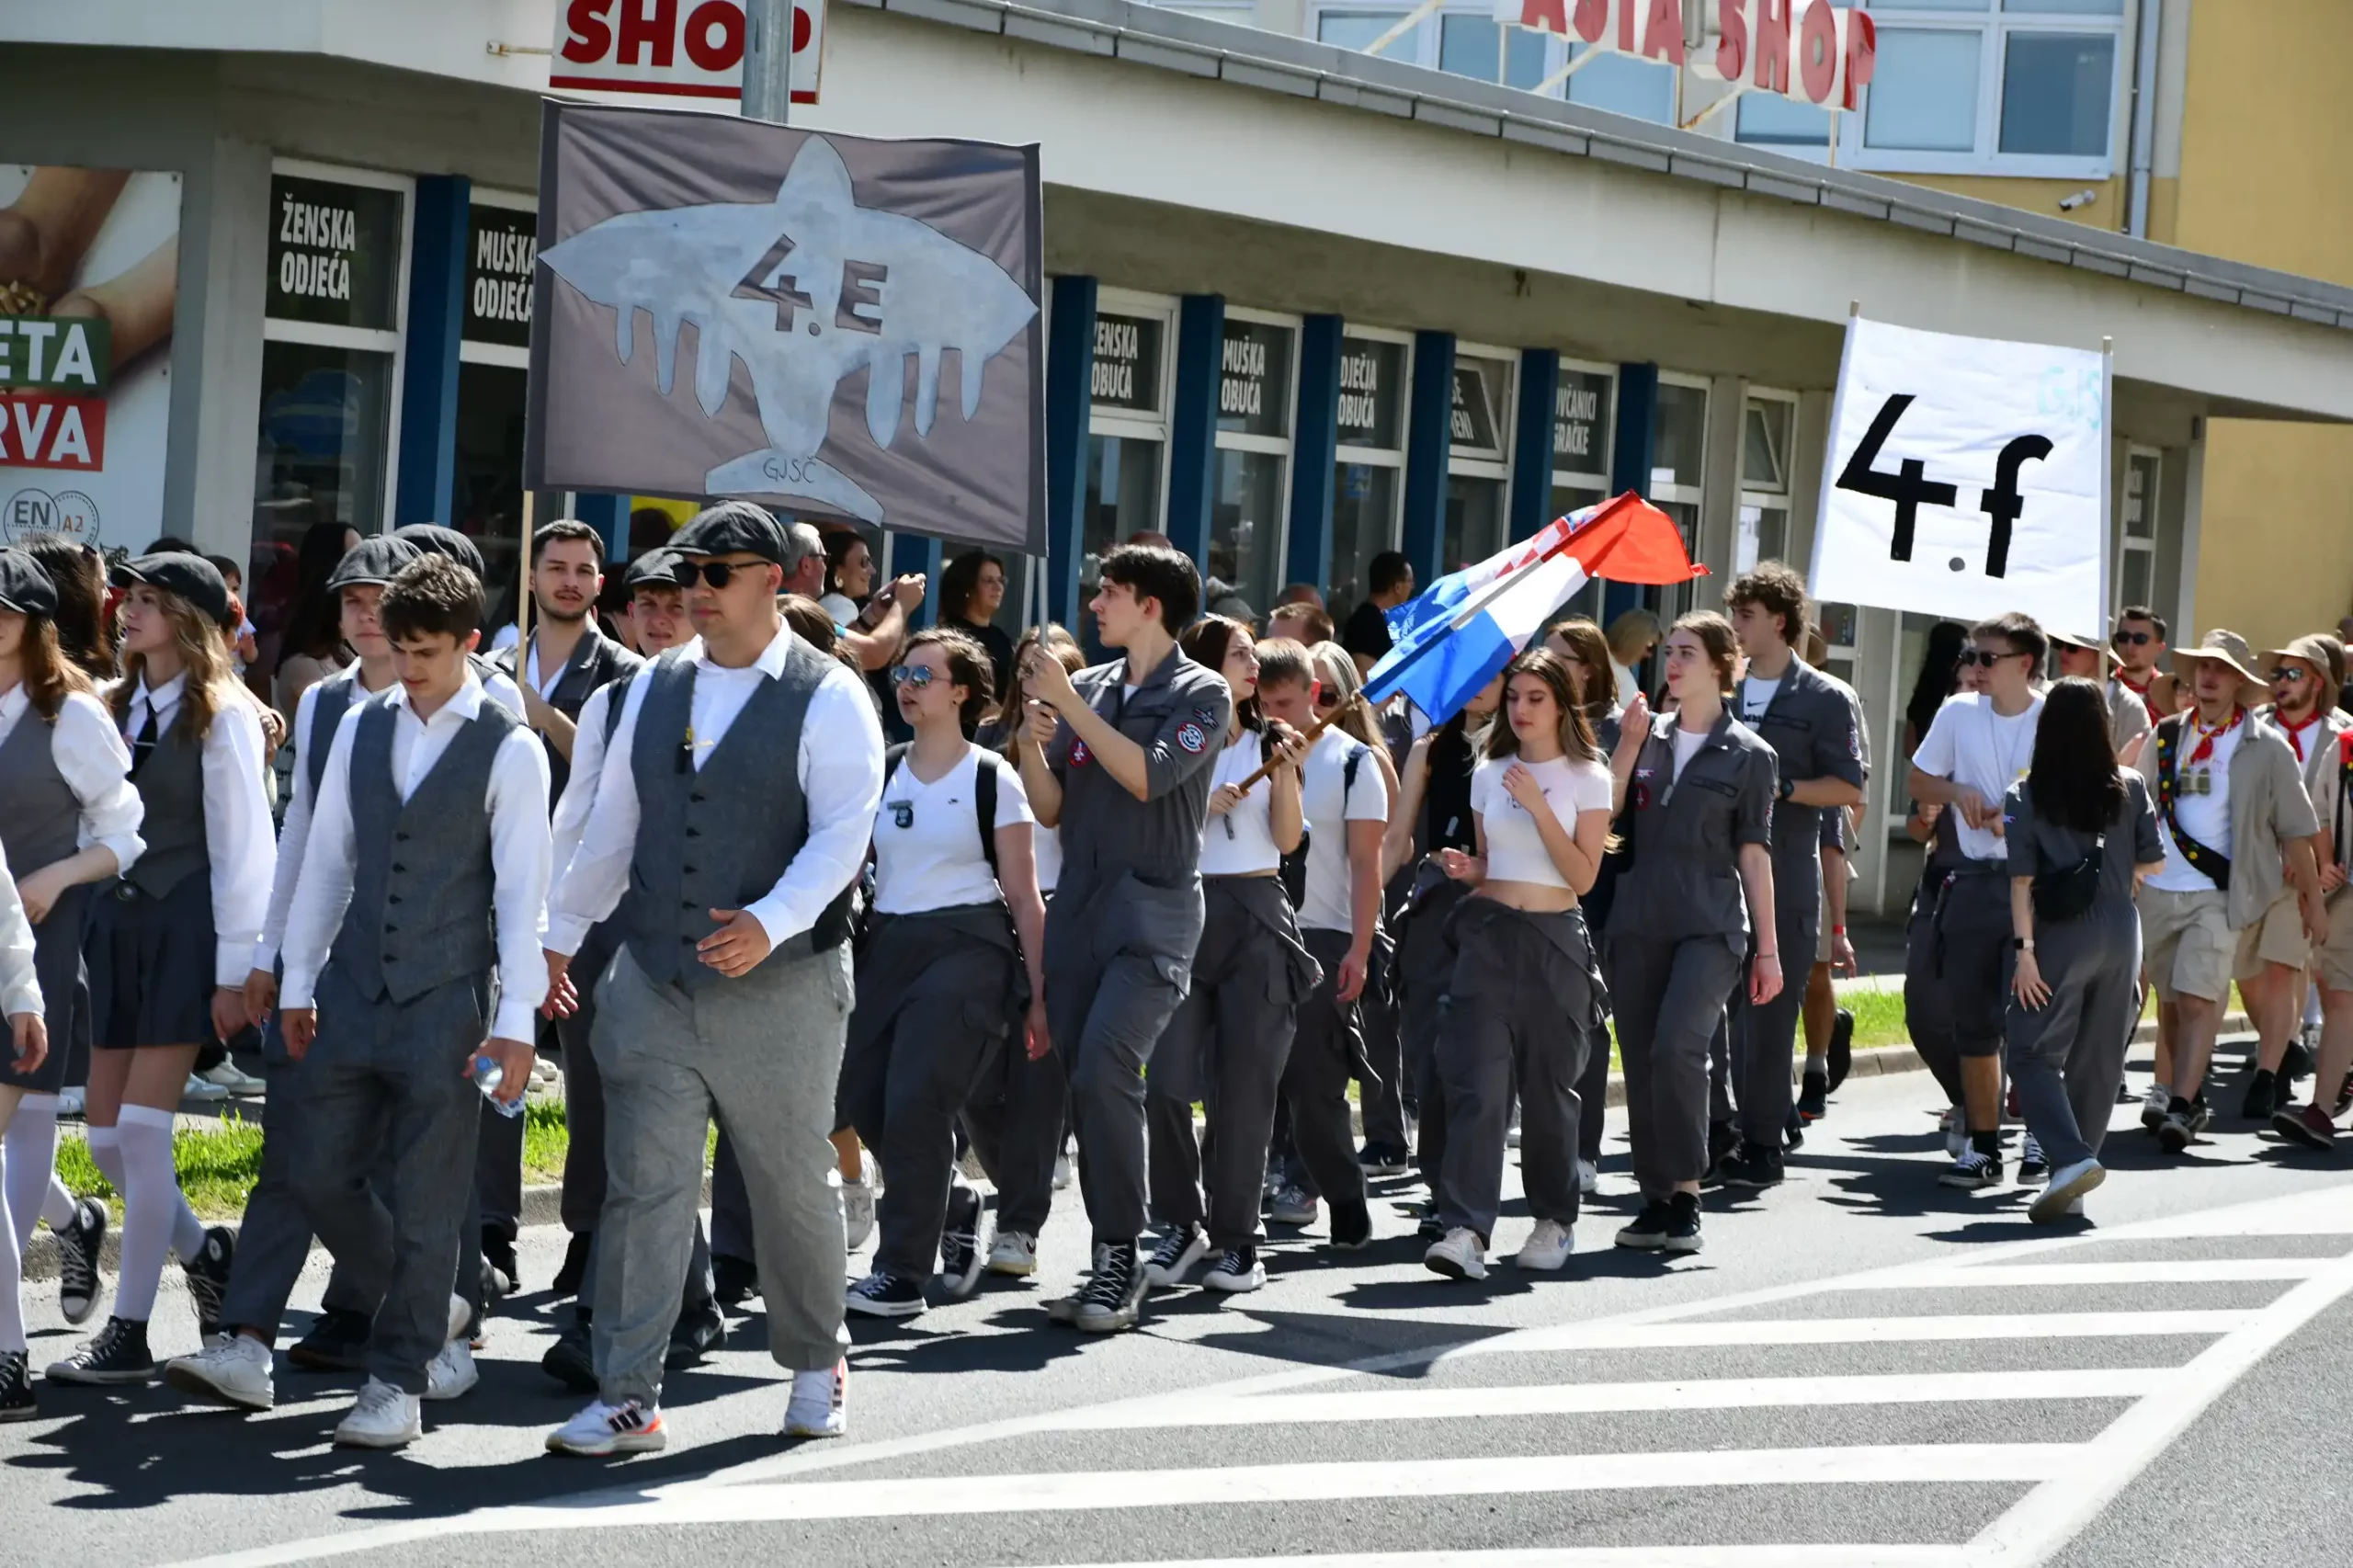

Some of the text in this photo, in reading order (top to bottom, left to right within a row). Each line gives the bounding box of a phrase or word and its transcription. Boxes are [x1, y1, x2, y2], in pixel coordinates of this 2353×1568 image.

[1715, 0, 1876, 111] SHOP
[280, 193, 356, 251] ŽENSKA
[477, 225, 537, 275] MUŠKA
[280, 251, 350, 300] ODJEĆA
[730, 233, 888, 335] 4.E
[473, 277, 534, 323] ODJEĆA
[1222, 335, 1265, 376] MUŠKA
[1340, 353, 1377, 391] DJEČJA
[1091, 359, 1132, 399] OBUĆA
[1221, 376, 1261, 415] OBUĆA
[0, 402, 92, 463] VA
[1337, 391, 1375, 428] OBUĆA
[1835, 393, 2054, 579] 4.f
[14, 500, 51, 525] EN
[63, 515, 84, 532] A2
